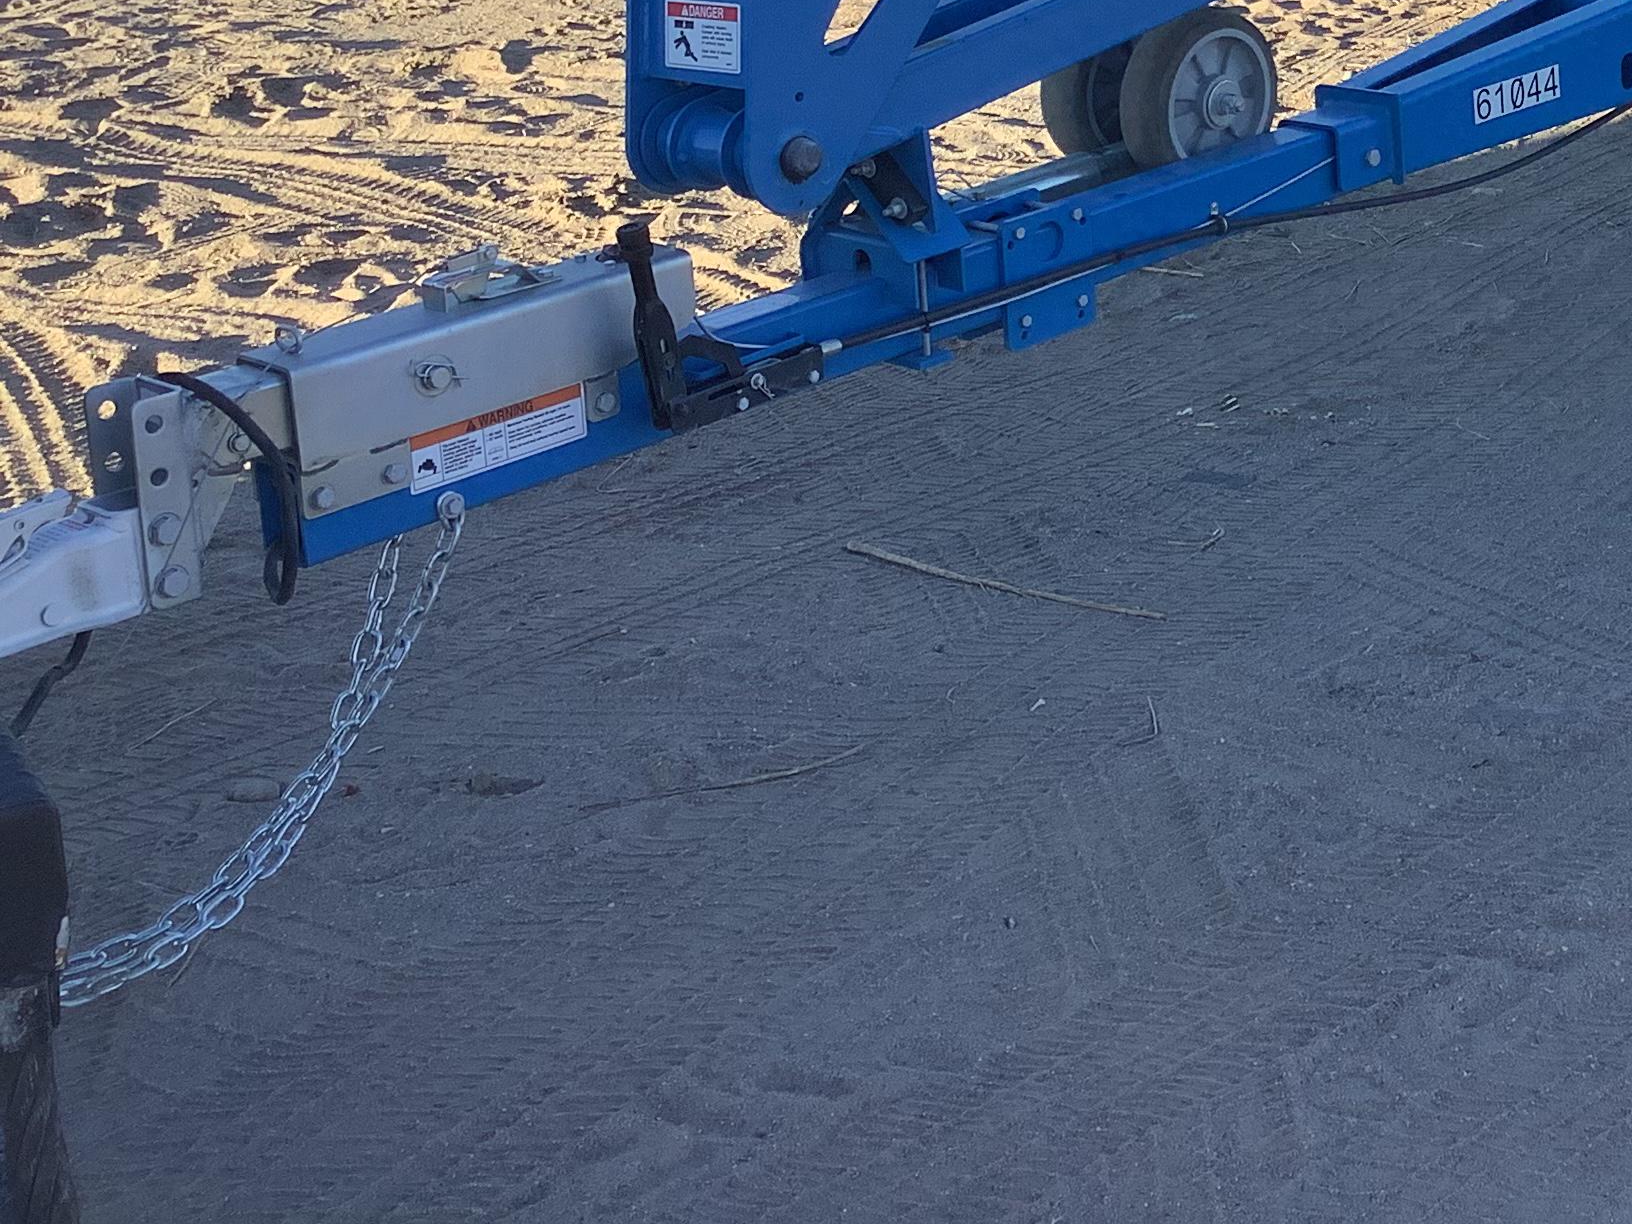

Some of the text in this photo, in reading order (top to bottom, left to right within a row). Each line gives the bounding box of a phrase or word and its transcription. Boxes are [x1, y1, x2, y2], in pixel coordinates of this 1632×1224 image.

[688, 5, 724, 19] DANGER
[1476, 66, 1559, 120] 61044
[477, 400, 534, 426] WARNING
